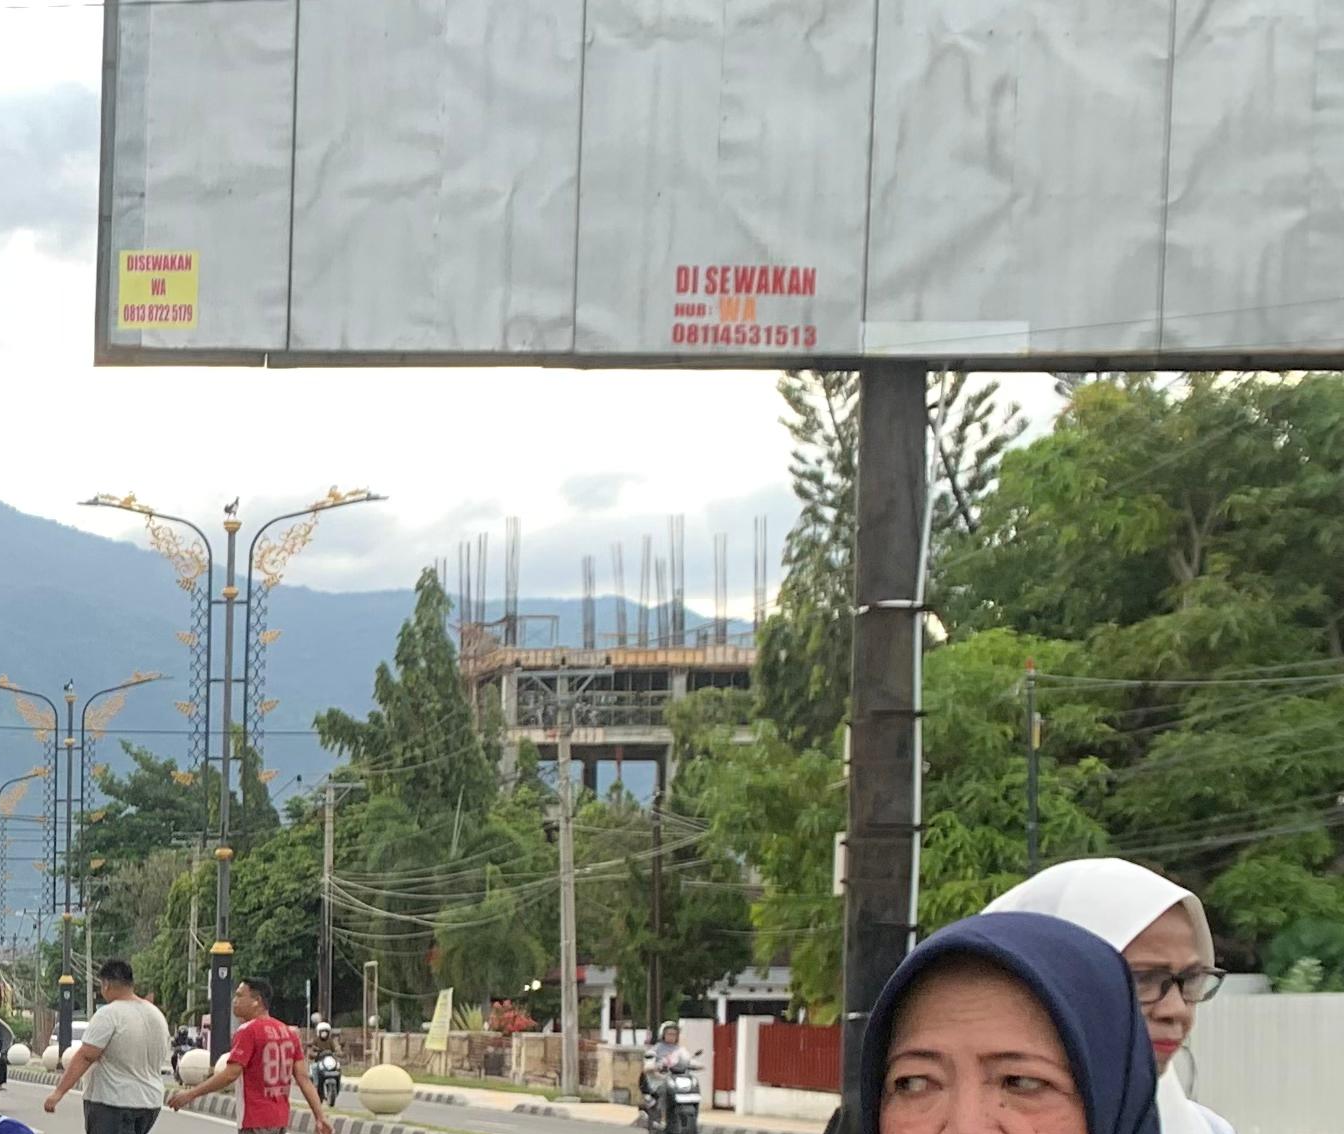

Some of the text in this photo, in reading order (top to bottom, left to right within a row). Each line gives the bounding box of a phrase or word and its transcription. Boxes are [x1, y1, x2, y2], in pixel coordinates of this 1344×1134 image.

[127, 254, 192, 271] DISEWAKAN
[151, 278, 166, 295] WA
[676, 265, 816, 295] DI SEWAKAN
[123, 304, 145, 322] 0813
[148, 304, 170, 322] 8722
[720, 297, 756, 321] WA
[672, 323, 816, 347] 08114531513
[263, 1041, 295, 1086] 86
